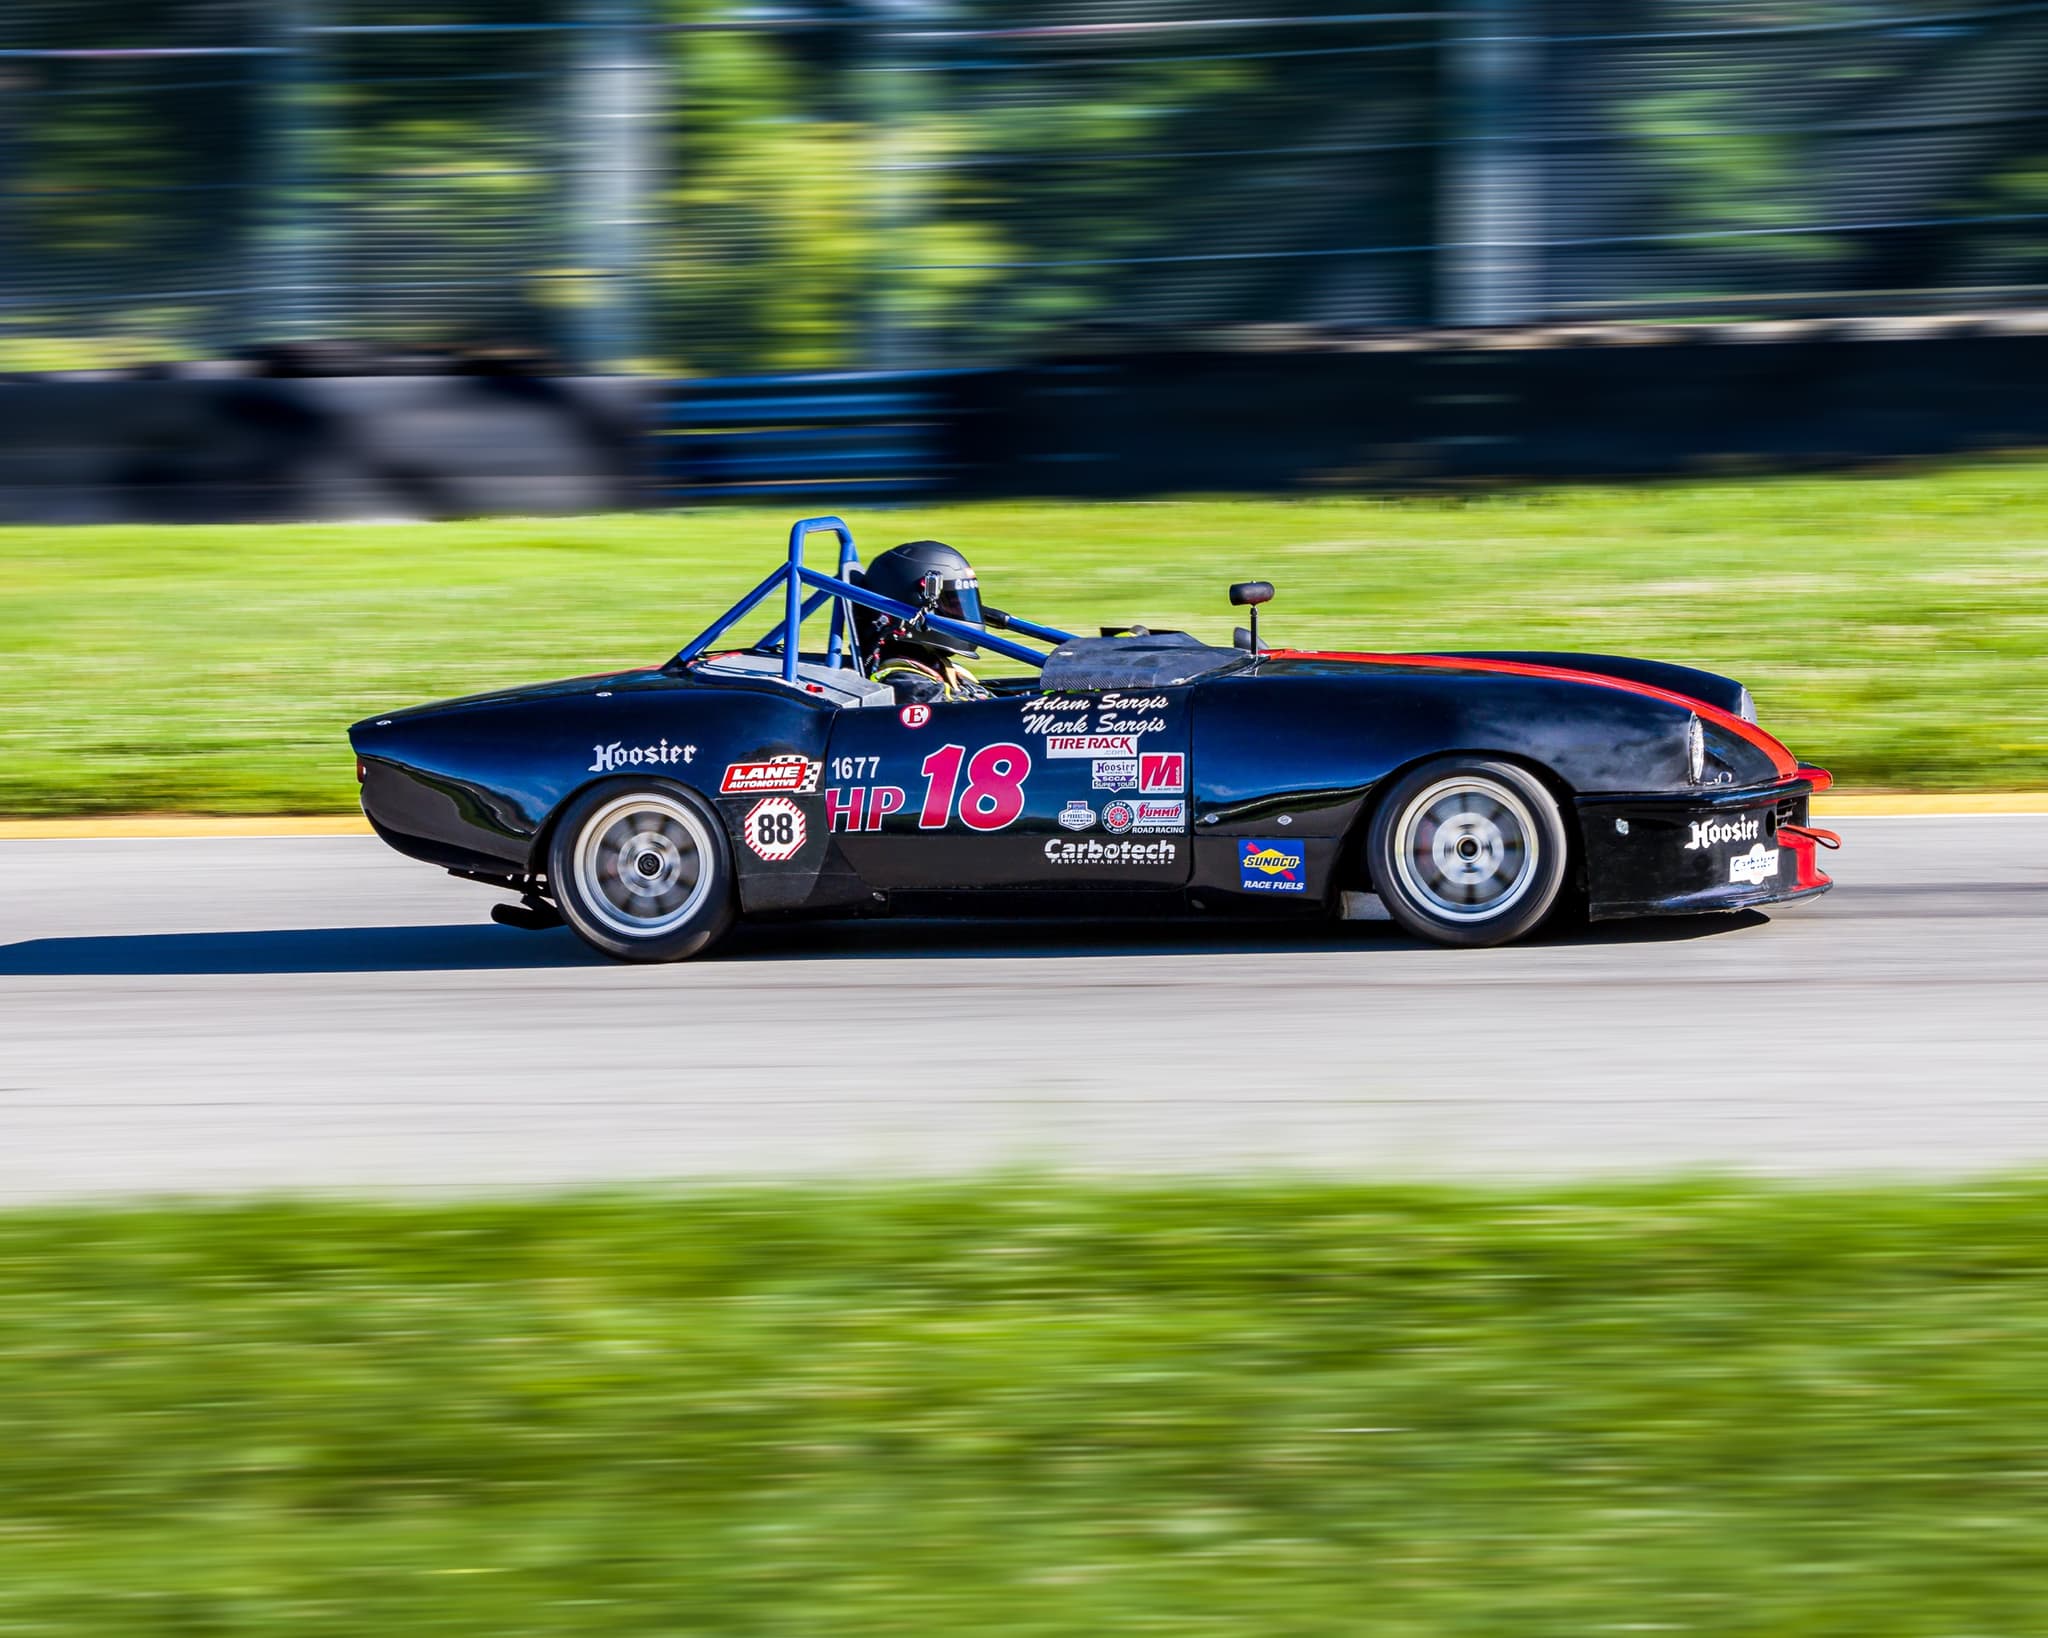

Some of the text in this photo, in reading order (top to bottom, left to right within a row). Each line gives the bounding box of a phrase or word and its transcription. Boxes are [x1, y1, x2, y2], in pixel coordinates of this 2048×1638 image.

[1021, 693, 1168, 715] Adam Sargis
[907, 706, 924, 724] E
[1022, 713, 1167, 738] Mark Sargis
[588, 738, 697, 772] Hoosier
[1050, 737, 1133, 754] TIRE RACK
[732, 766, 800, 780] LANE
[832, 756, 880, 780] 1677
[728, 779, 797, 789] AUTOMOTIVE
[919, 742, 1032, 831] 18
[825, 786, 906, 833] HP
[757, 813, 794, 845] 88
[1132, 826, 1185, 834] ROAD RACING
[1044, 838, 1176, 859] Carbotech
[1246, 856, 1297, 867] SUNOCO
[1243, 880, 1305, 890] RACE FUELS
